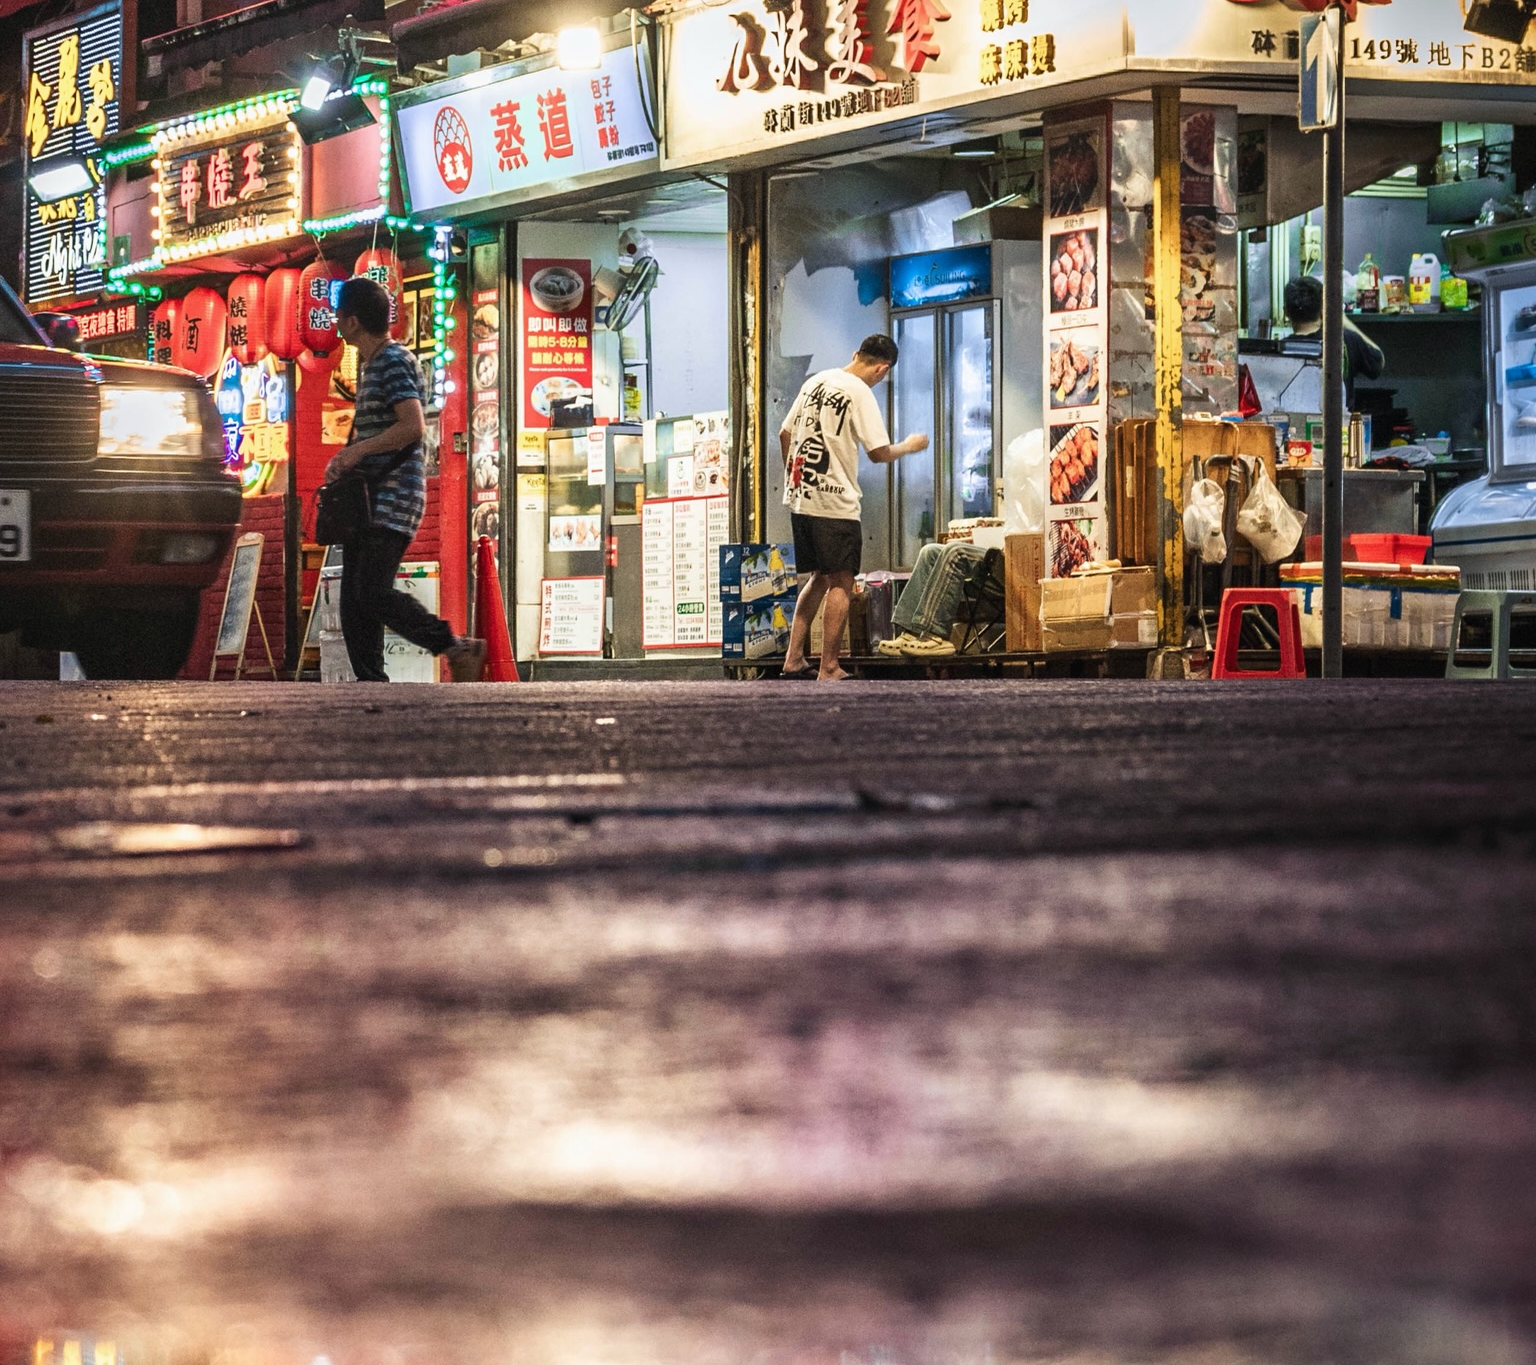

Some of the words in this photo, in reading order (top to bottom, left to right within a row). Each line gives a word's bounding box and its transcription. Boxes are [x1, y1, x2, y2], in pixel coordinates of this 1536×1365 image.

[590, 75, 612, 99] 包子
[490, 87, 573, 172] 蒸道
[180, 141, 268, 224] 串燒王
[310, 278, 331, 331] 串燒
[527, 317, 588, 333] 即叫即做
